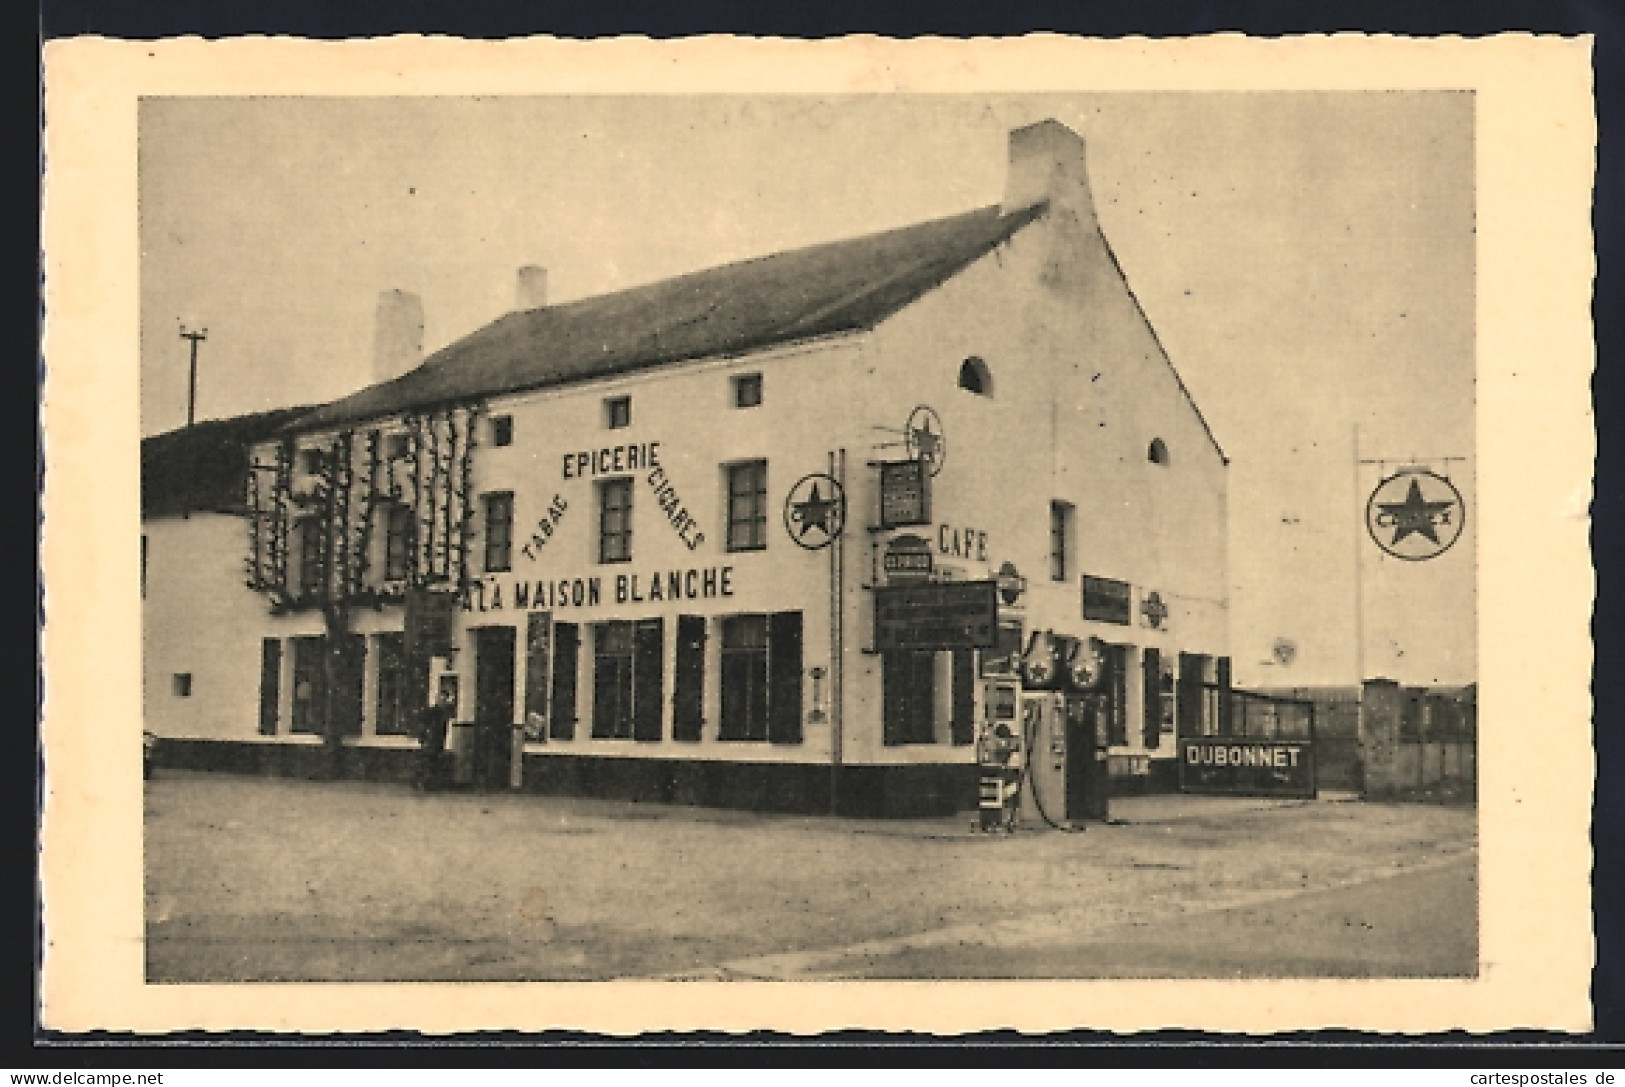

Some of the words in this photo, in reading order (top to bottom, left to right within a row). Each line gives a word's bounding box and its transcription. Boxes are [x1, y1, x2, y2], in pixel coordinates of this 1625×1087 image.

[563, 442, 660, 479] EPICERIE
[522, 494, 568, 562] TABAC
[648, 467, 705, 551] CIGARES
[479, 582, 503, 612] LA
[515, 577, 601, 610] MAISON
[615, 566, 734, 605] BLANCHE
[1187, 745, 1301, 768] DUBONNET
